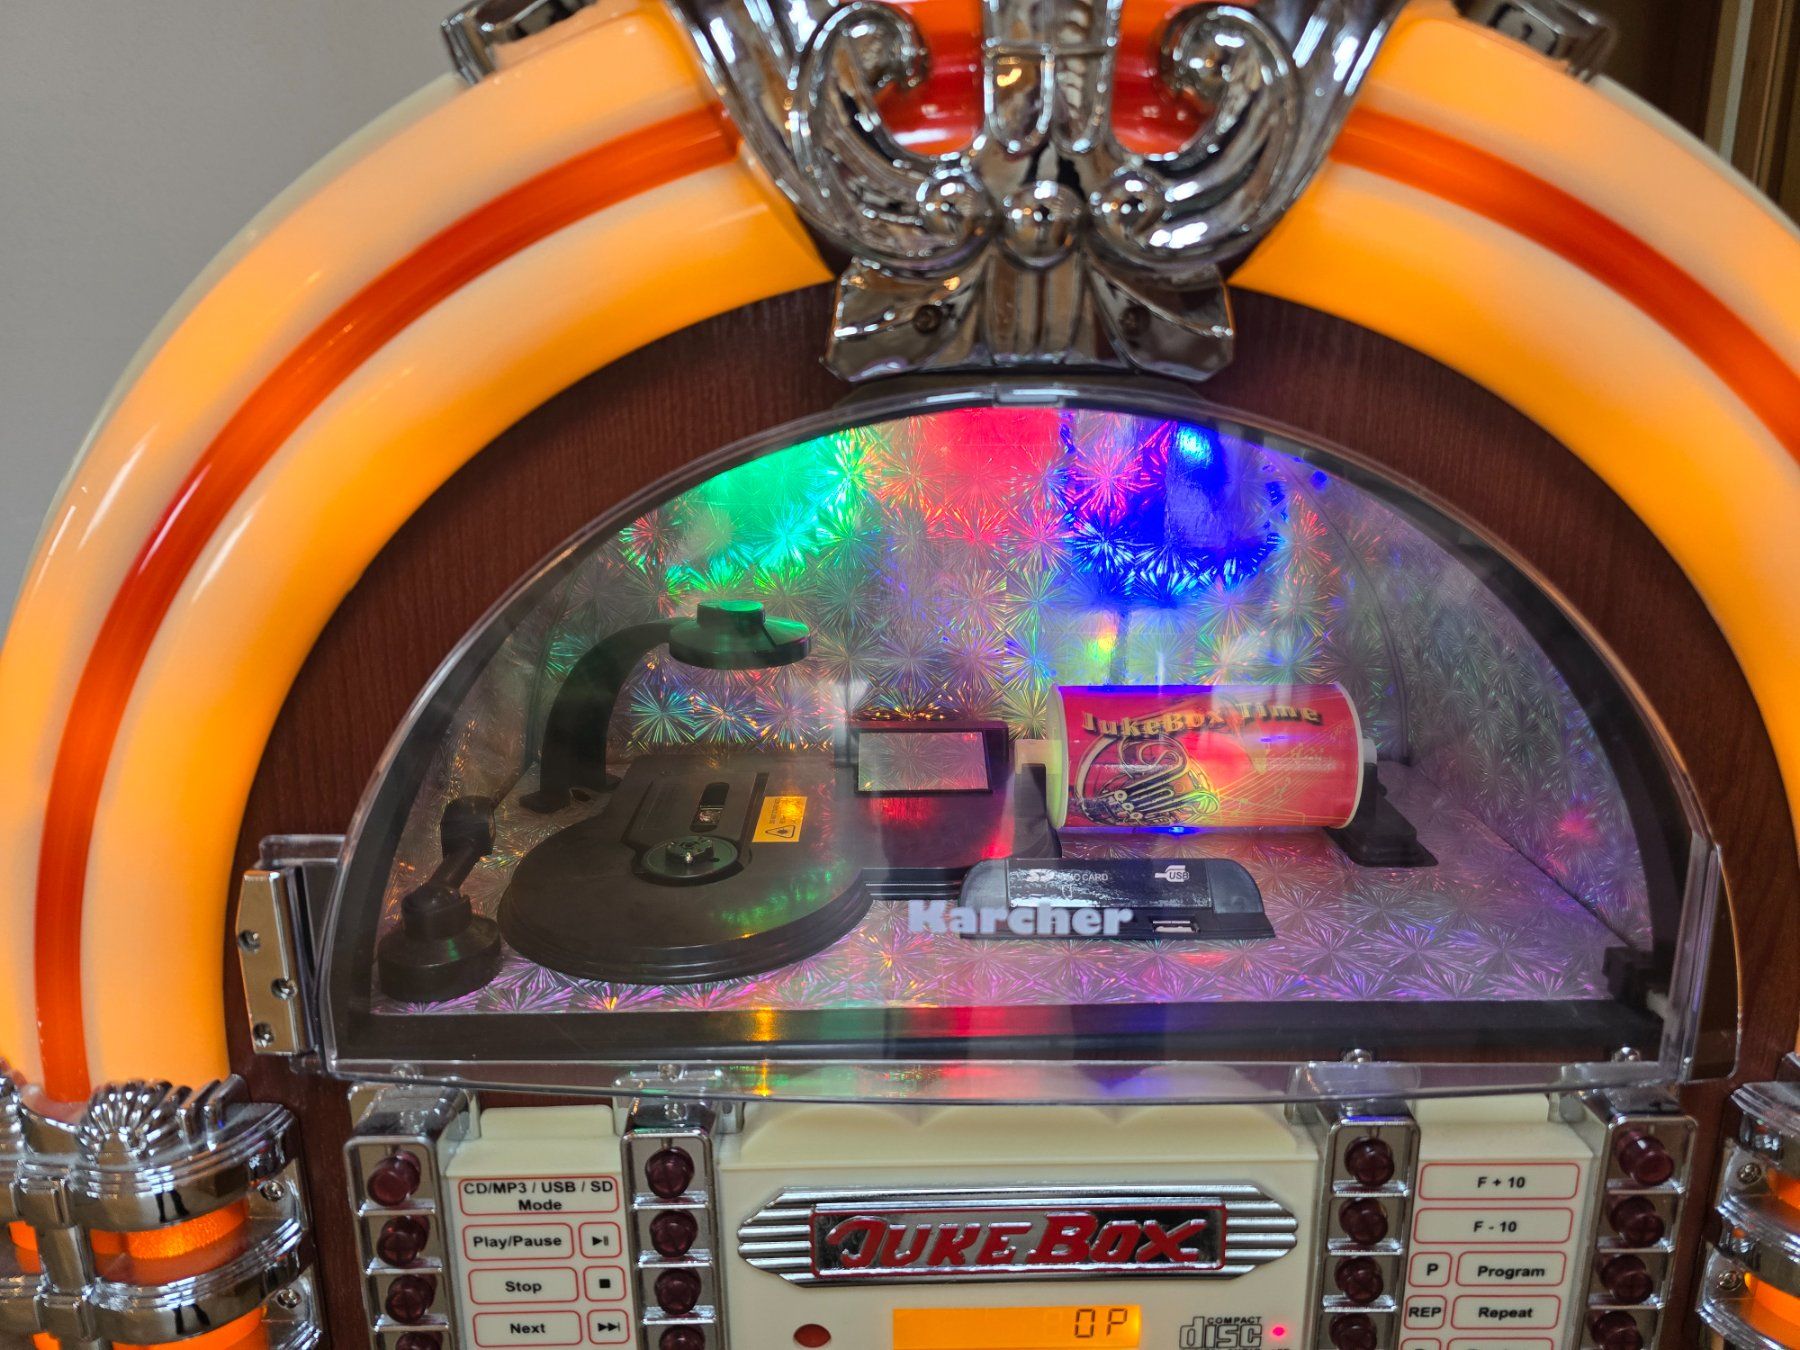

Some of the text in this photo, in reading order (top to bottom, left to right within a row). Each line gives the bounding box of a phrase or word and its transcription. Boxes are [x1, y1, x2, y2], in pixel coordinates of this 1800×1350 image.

[1236, 702, 1323, 725] Time
[1082, 873, 1108, 881] CARD
[1169, 871, 1189, 880] USB
[908, 899, 1134, 936] Karcher
[463, 1182, 527, 1195] CD/MP3
[541, 1181, 576, 1193] USB
[590, 1180, 613, 1192] SD
[1477, 1176, 1488, 1188] F
[1507, 1176, 1526, 1189] 10
[518, 1199, 562, 1211] Mode
[1473, 1221, 1484, 1232] F
[1500, 1221, 1517, 1232] 10
[473, 1235, 562, 1250] Play/Pause
[1426, 1263, 1438, 1276] P
[1477, 1265, 1545, 1280] Program
[505, 1281, 542, 1294] Stop
[1408, 1307, 1442, 1318] REP
[1478, 1307, 1533, 1320] Repeat
[1207, 1316, 1261, 1324] COMPACT
[510, 1323, 546, 1334] Next
